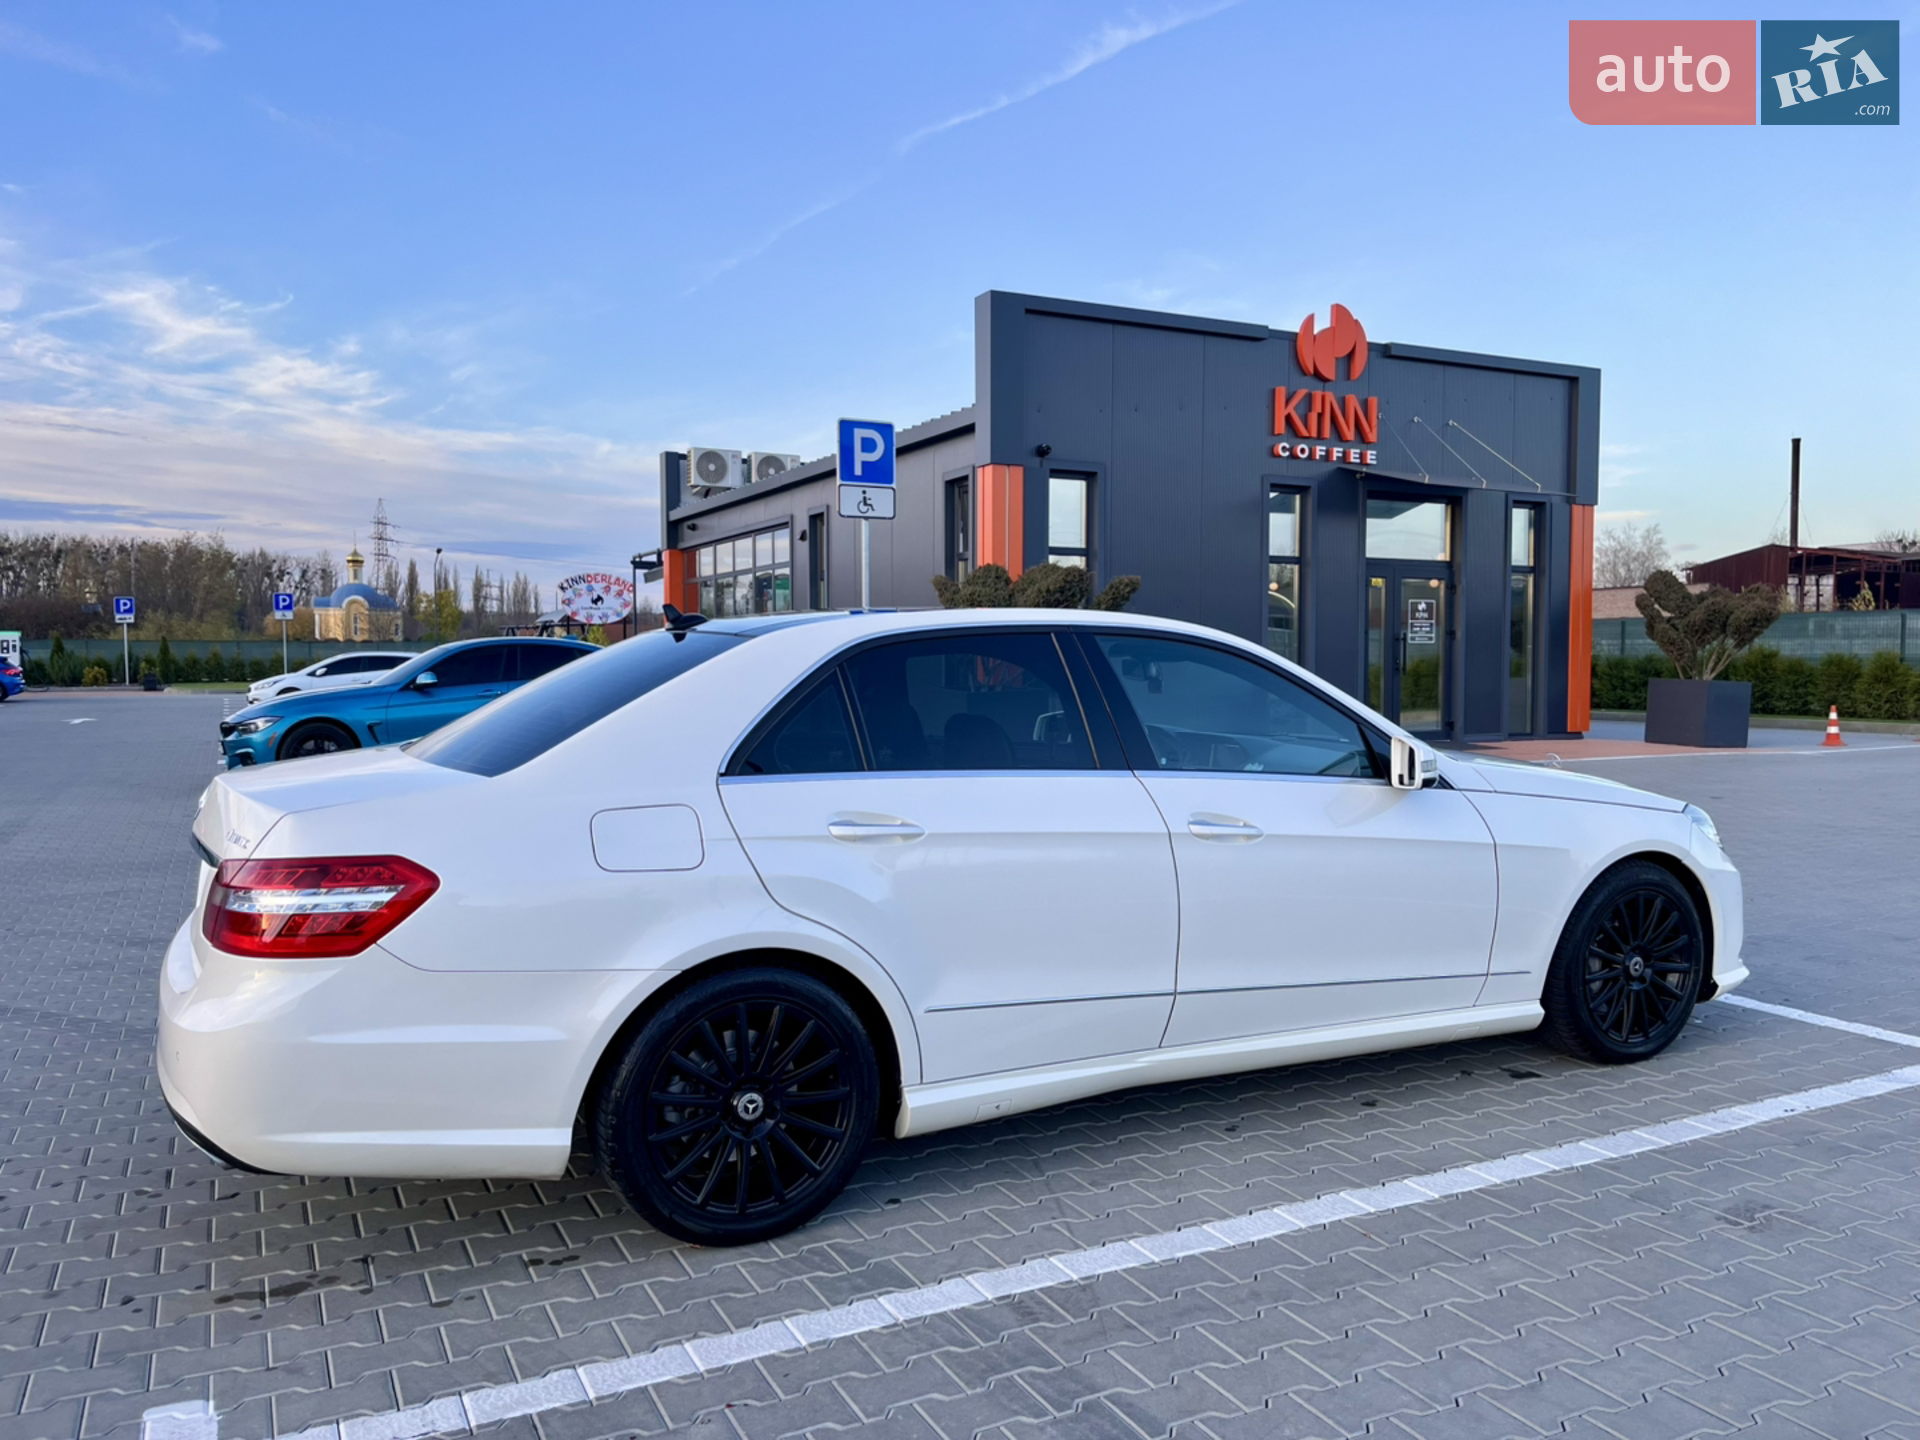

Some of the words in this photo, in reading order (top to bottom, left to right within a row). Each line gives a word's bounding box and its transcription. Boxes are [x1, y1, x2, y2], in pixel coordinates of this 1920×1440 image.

[1273, 386, 1379, 444] KINN
[853, 427, 886, 477] P
[1274, 442, 1378, 465] COFFEE
[120, 599, 131, 613] P
[278, 595, 291, 609] P
